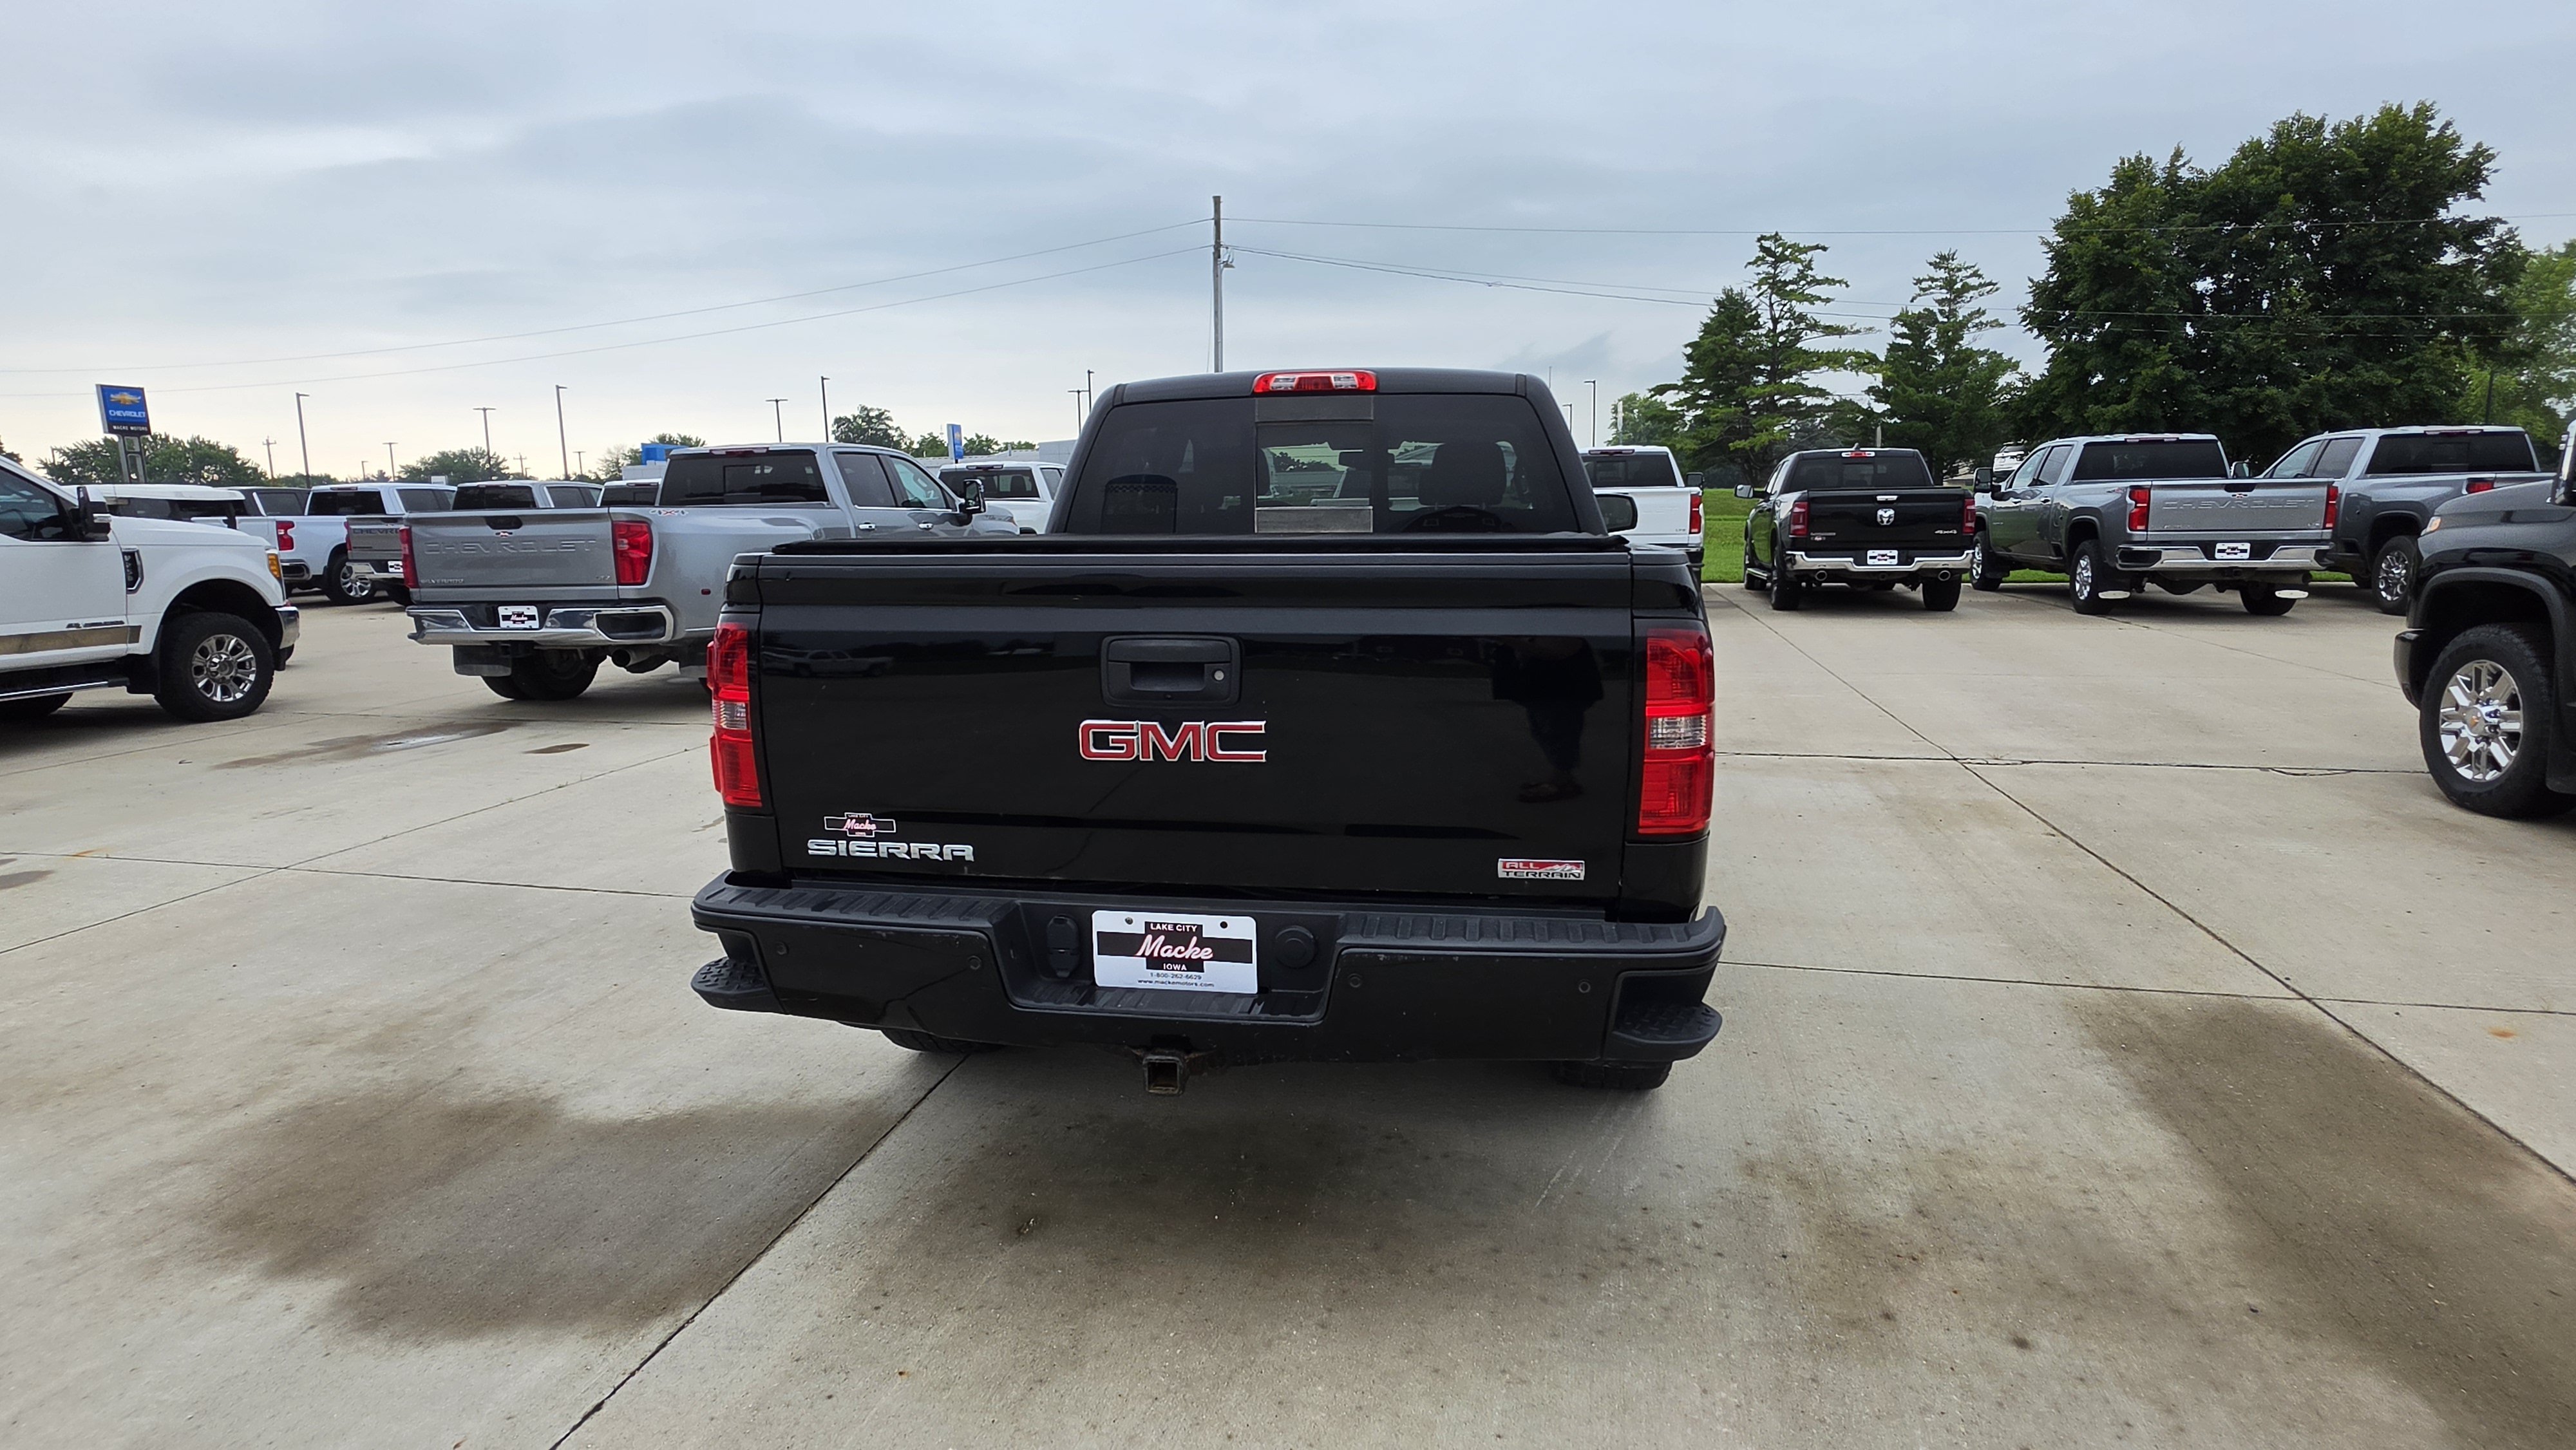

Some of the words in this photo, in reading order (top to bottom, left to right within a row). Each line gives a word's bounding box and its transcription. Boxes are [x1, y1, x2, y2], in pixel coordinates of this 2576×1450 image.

[109, 410, 146, 418] CHEVROLET
[424, 539, 596, 554] CHEVROLET
[1079, 719, 1267, 762] GMC
[843, 818, 876, 831] Macke
[807, 840, 974, 862] SIERRA
[1150, 923, 1174, 931] LAKE
[1134, 934, 1213, 959] Macke
